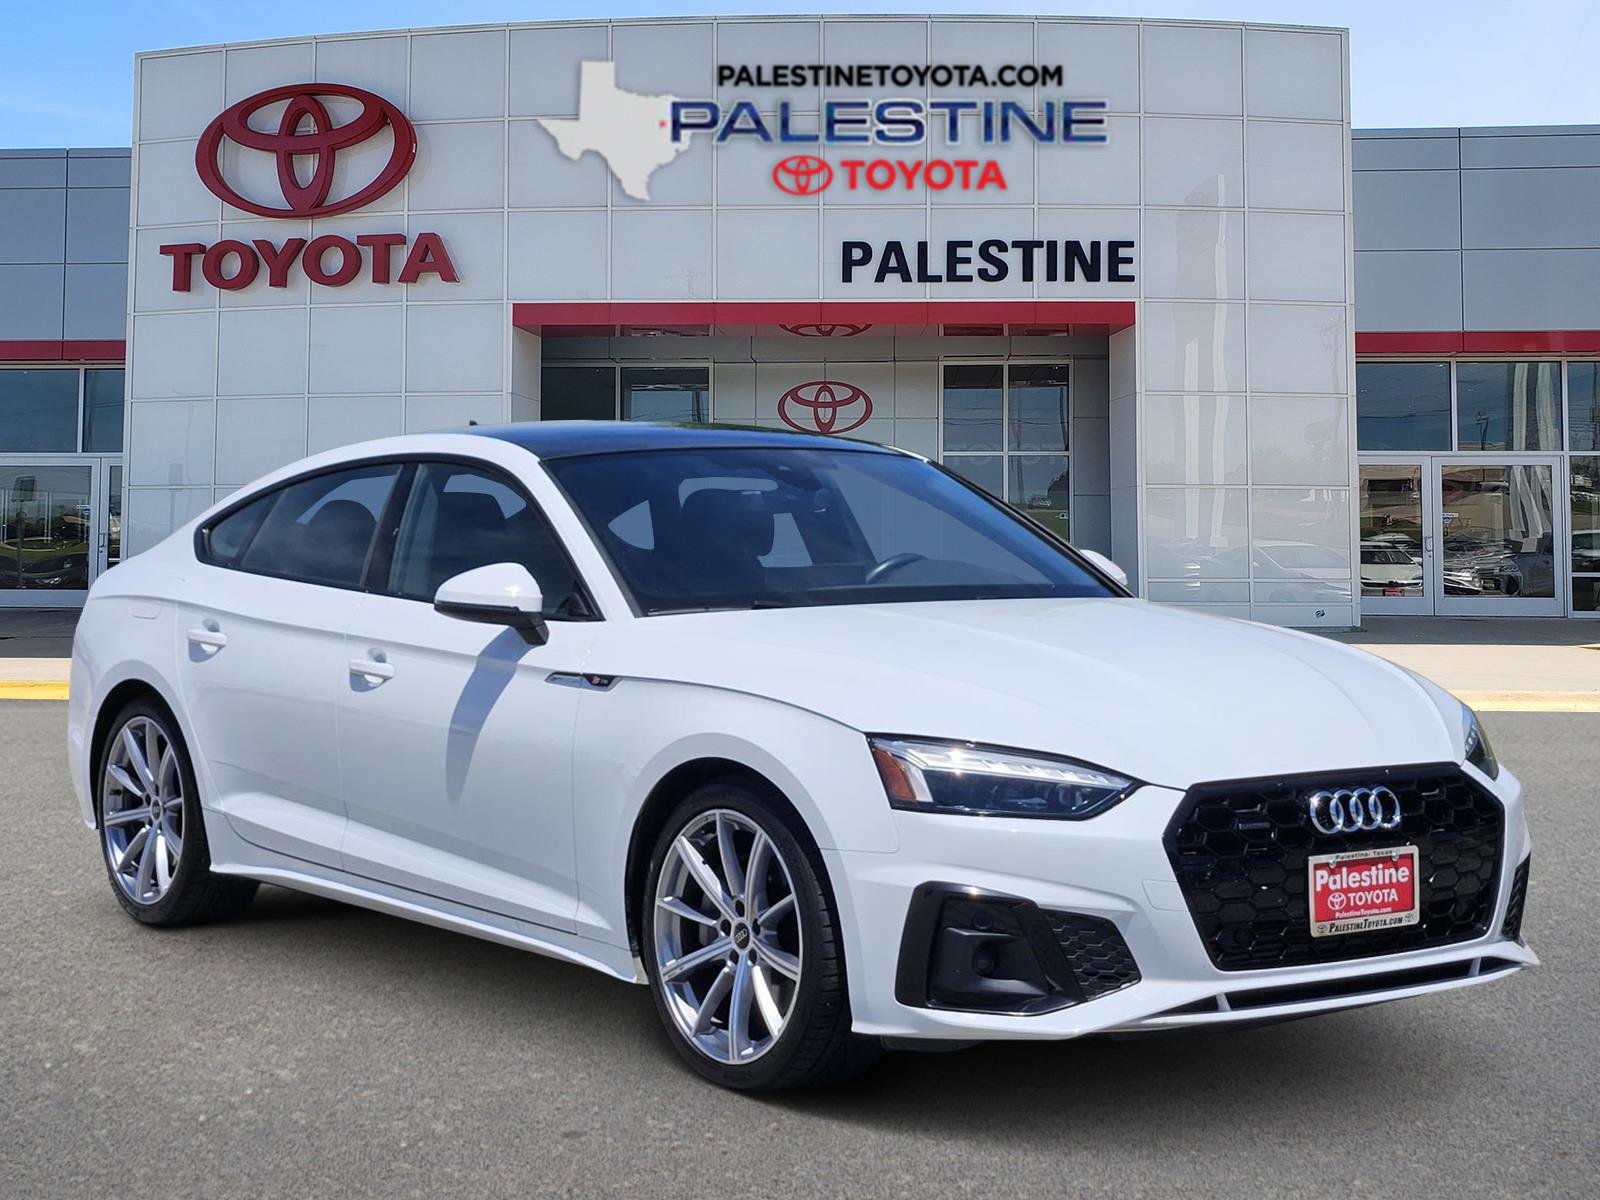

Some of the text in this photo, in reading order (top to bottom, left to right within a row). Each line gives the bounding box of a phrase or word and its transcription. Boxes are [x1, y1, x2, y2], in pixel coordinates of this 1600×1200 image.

[160, 232, 460, 292] TOYOTA
[841, 239, 1135, 283] PALESTINE
[1315, 864, 1410, 892] Palestine
[1347, 889, 1399, 907] TOYOTA
